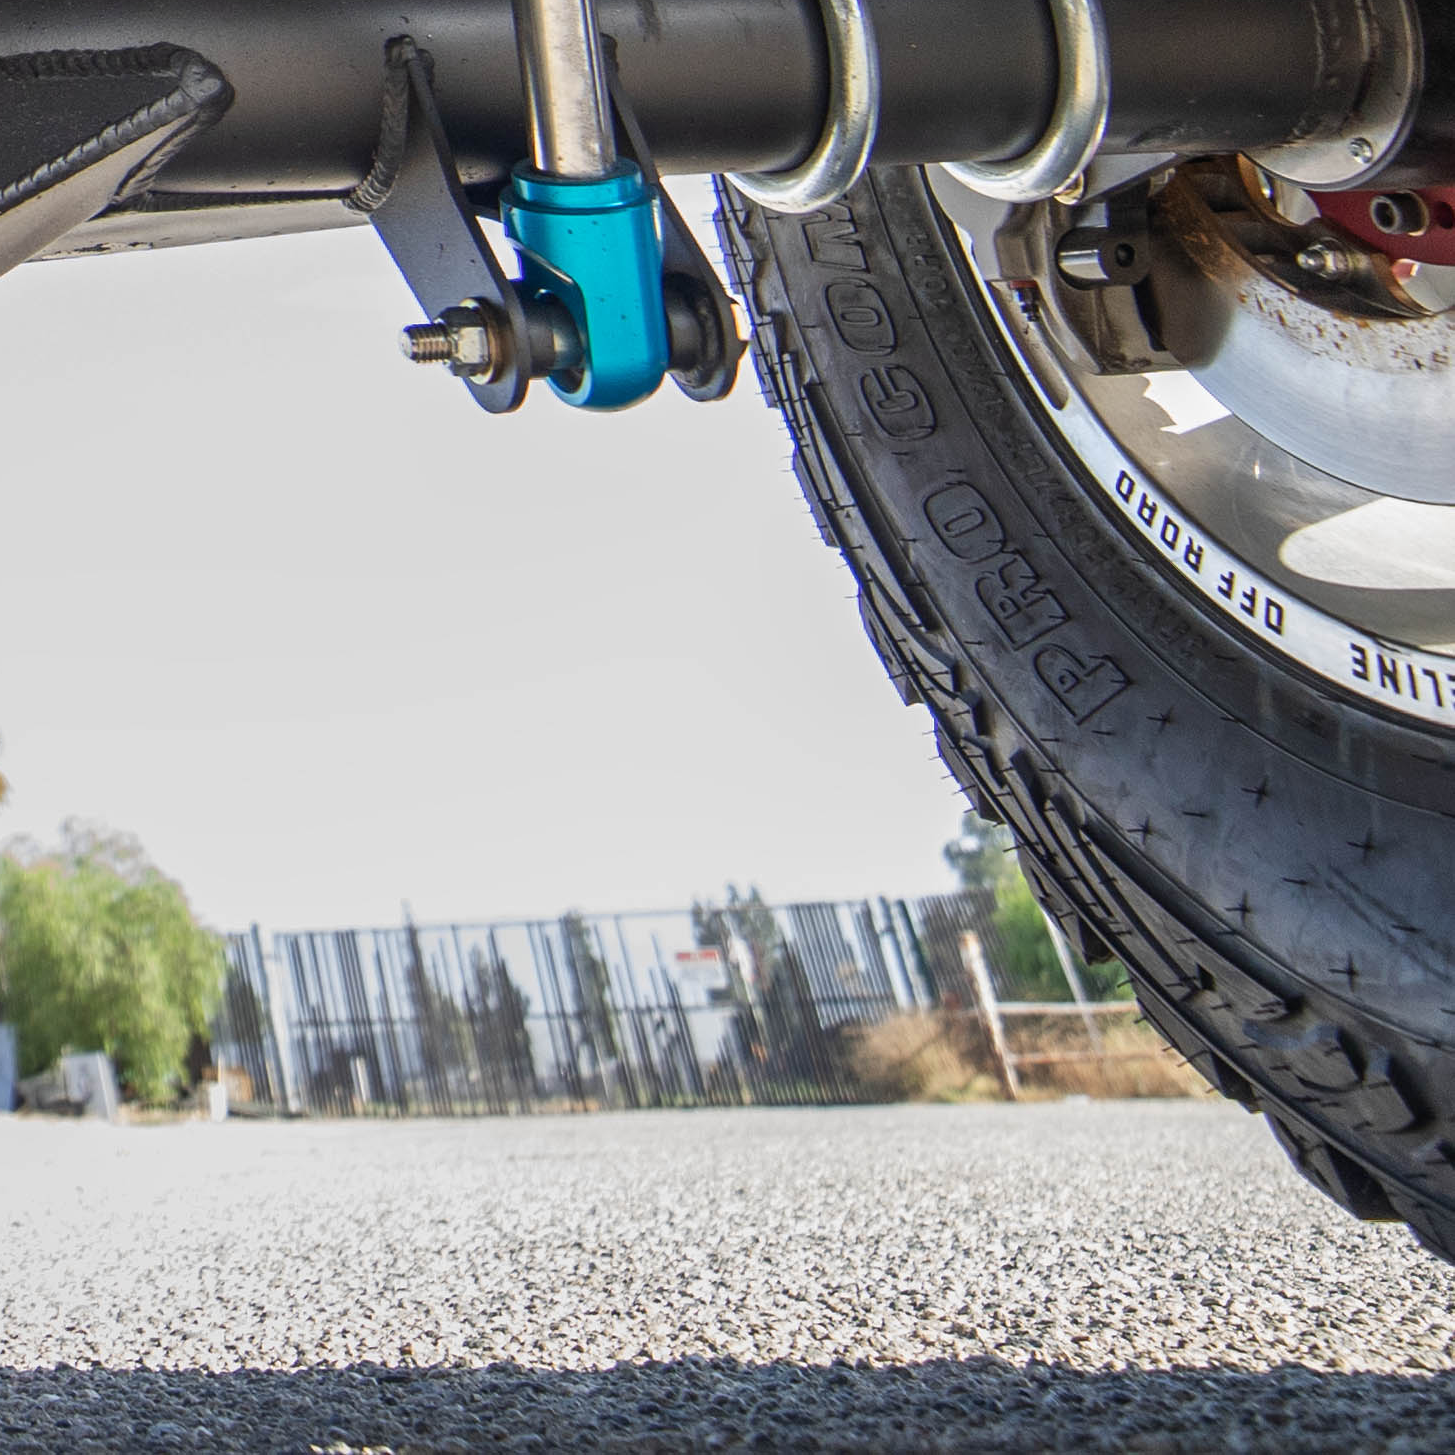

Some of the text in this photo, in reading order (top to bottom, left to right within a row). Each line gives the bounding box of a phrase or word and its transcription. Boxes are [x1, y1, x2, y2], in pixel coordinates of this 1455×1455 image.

[1114, 468, 1206, 577] ROAD
[922, 479, 1134, 727] PRO
[1217, 570, 1287, 637] OFF
